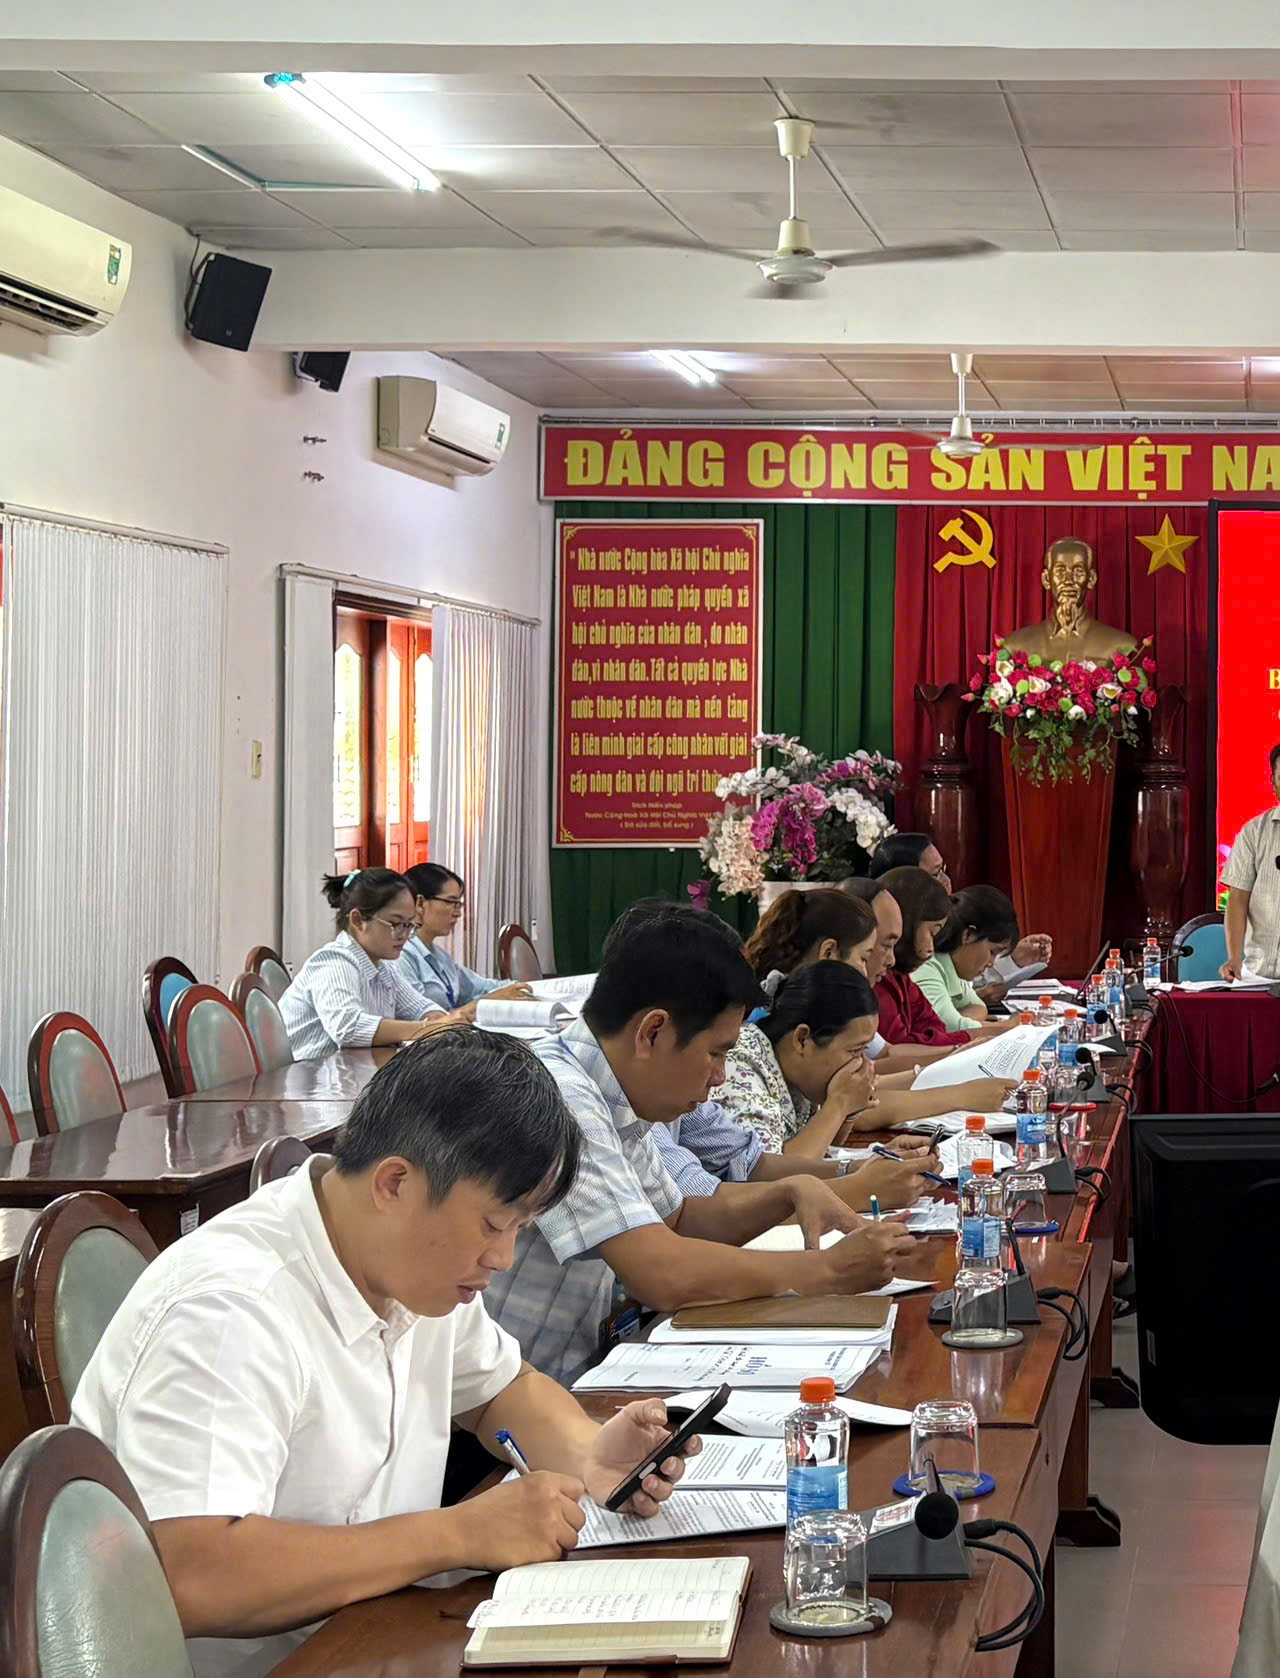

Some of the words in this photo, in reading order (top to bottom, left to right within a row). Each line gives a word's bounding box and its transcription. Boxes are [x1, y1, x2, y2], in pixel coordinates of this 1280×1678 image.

[564, 429, 725, 487] ĐẢNG
[748, 434, 909, 497] CỘNG
[930, 433, 1045, 491] SẢN
[1066, 436, 1191, 500] VIỆT
